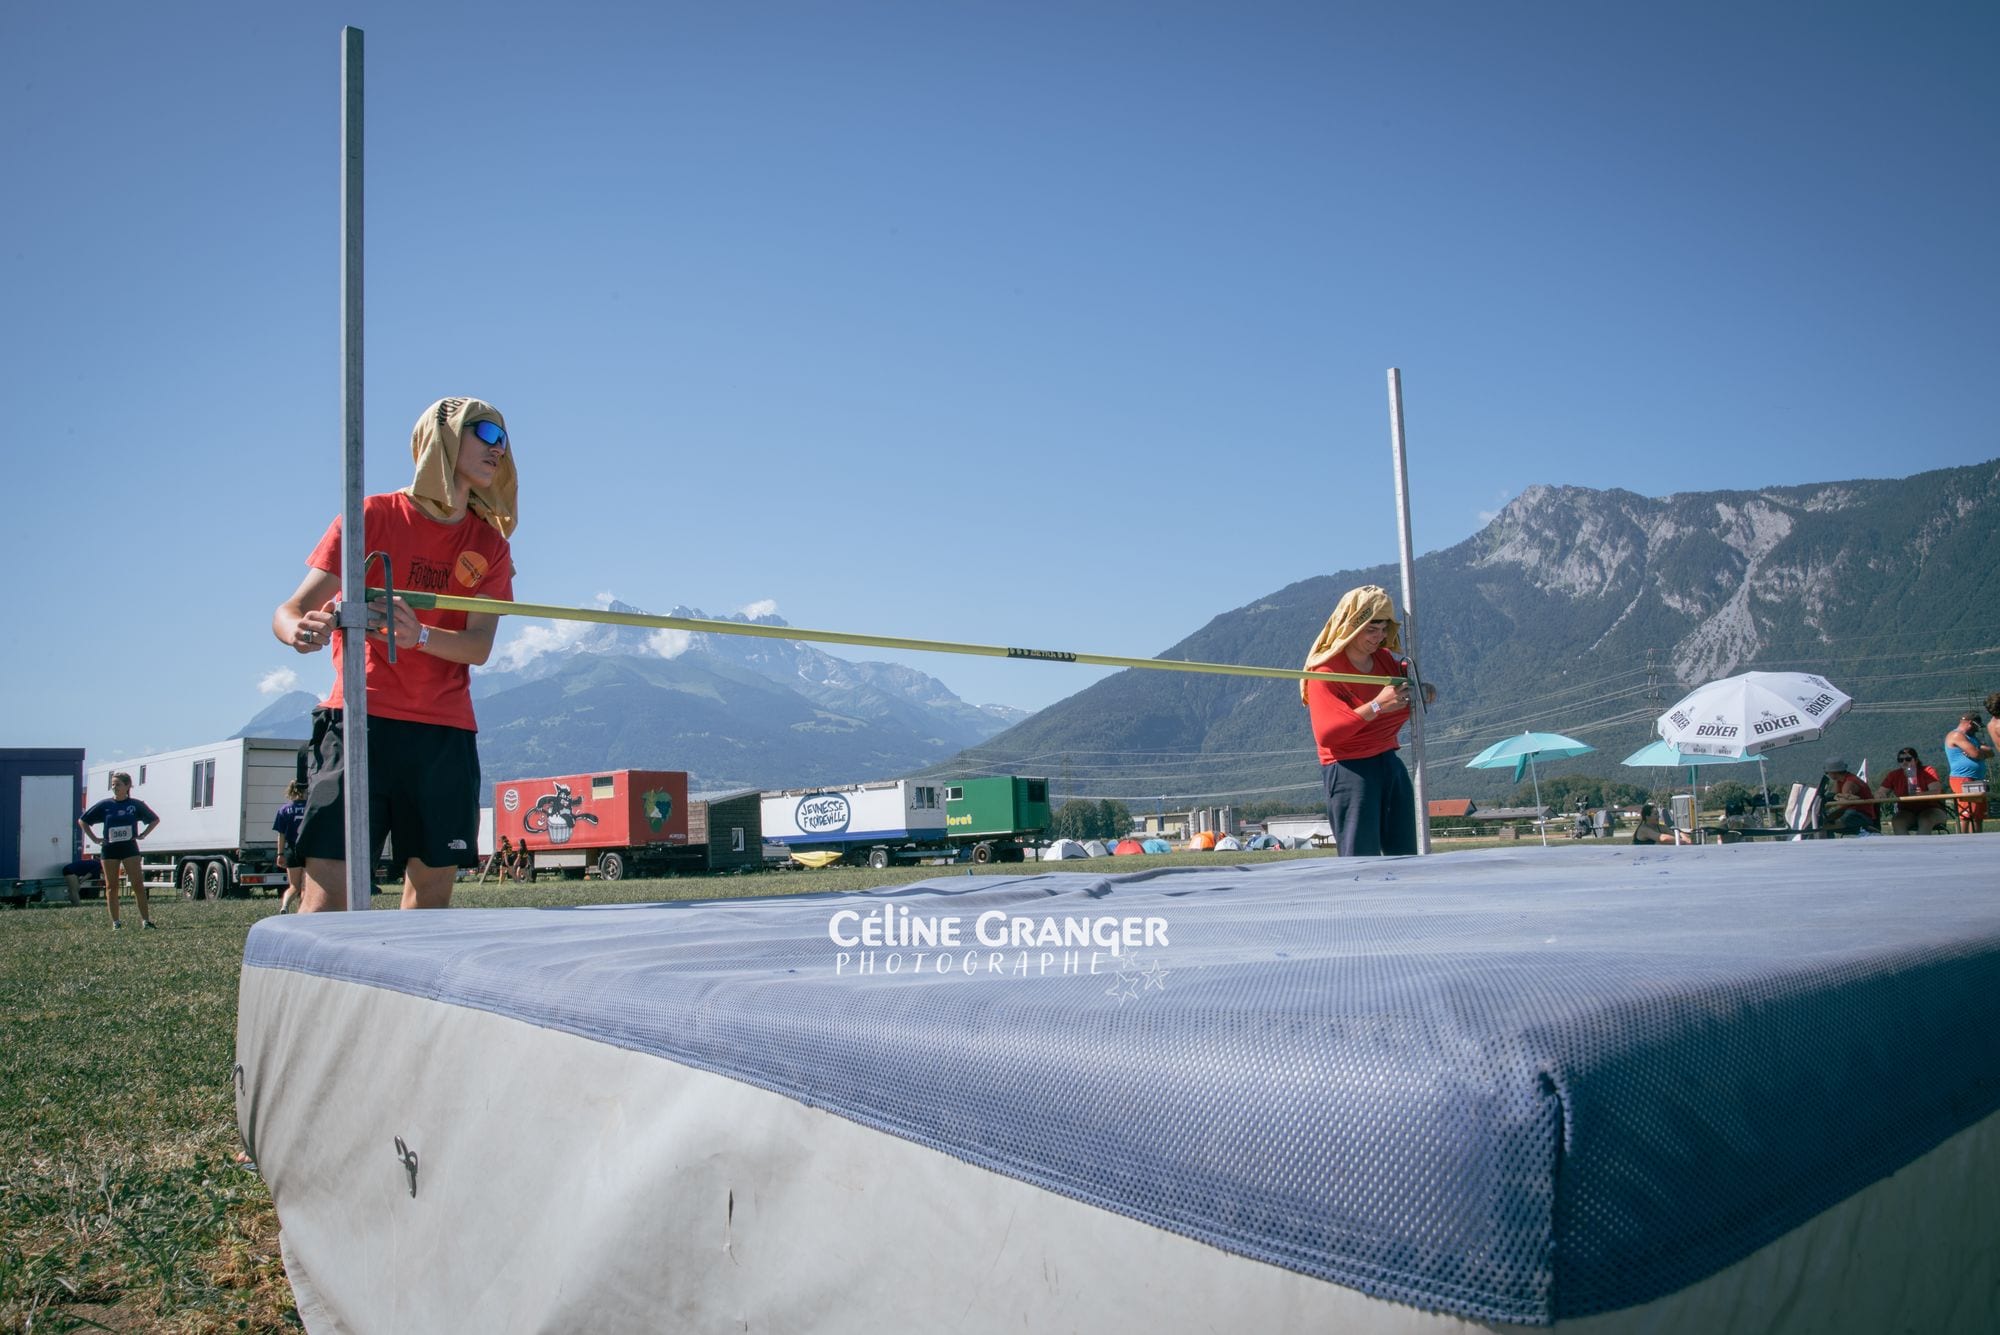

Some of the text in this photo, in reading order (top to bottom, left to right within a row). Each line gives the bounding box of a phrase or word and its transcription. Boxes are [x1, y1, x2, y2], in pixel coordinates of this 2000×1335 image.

[1805, 693, 1834, 716] BOXER
[1670, 710, 1690, 731] BOXER
[1753, 714, 1800, 735] BOXER
[1696, 725, 1739, 738] BOXER
